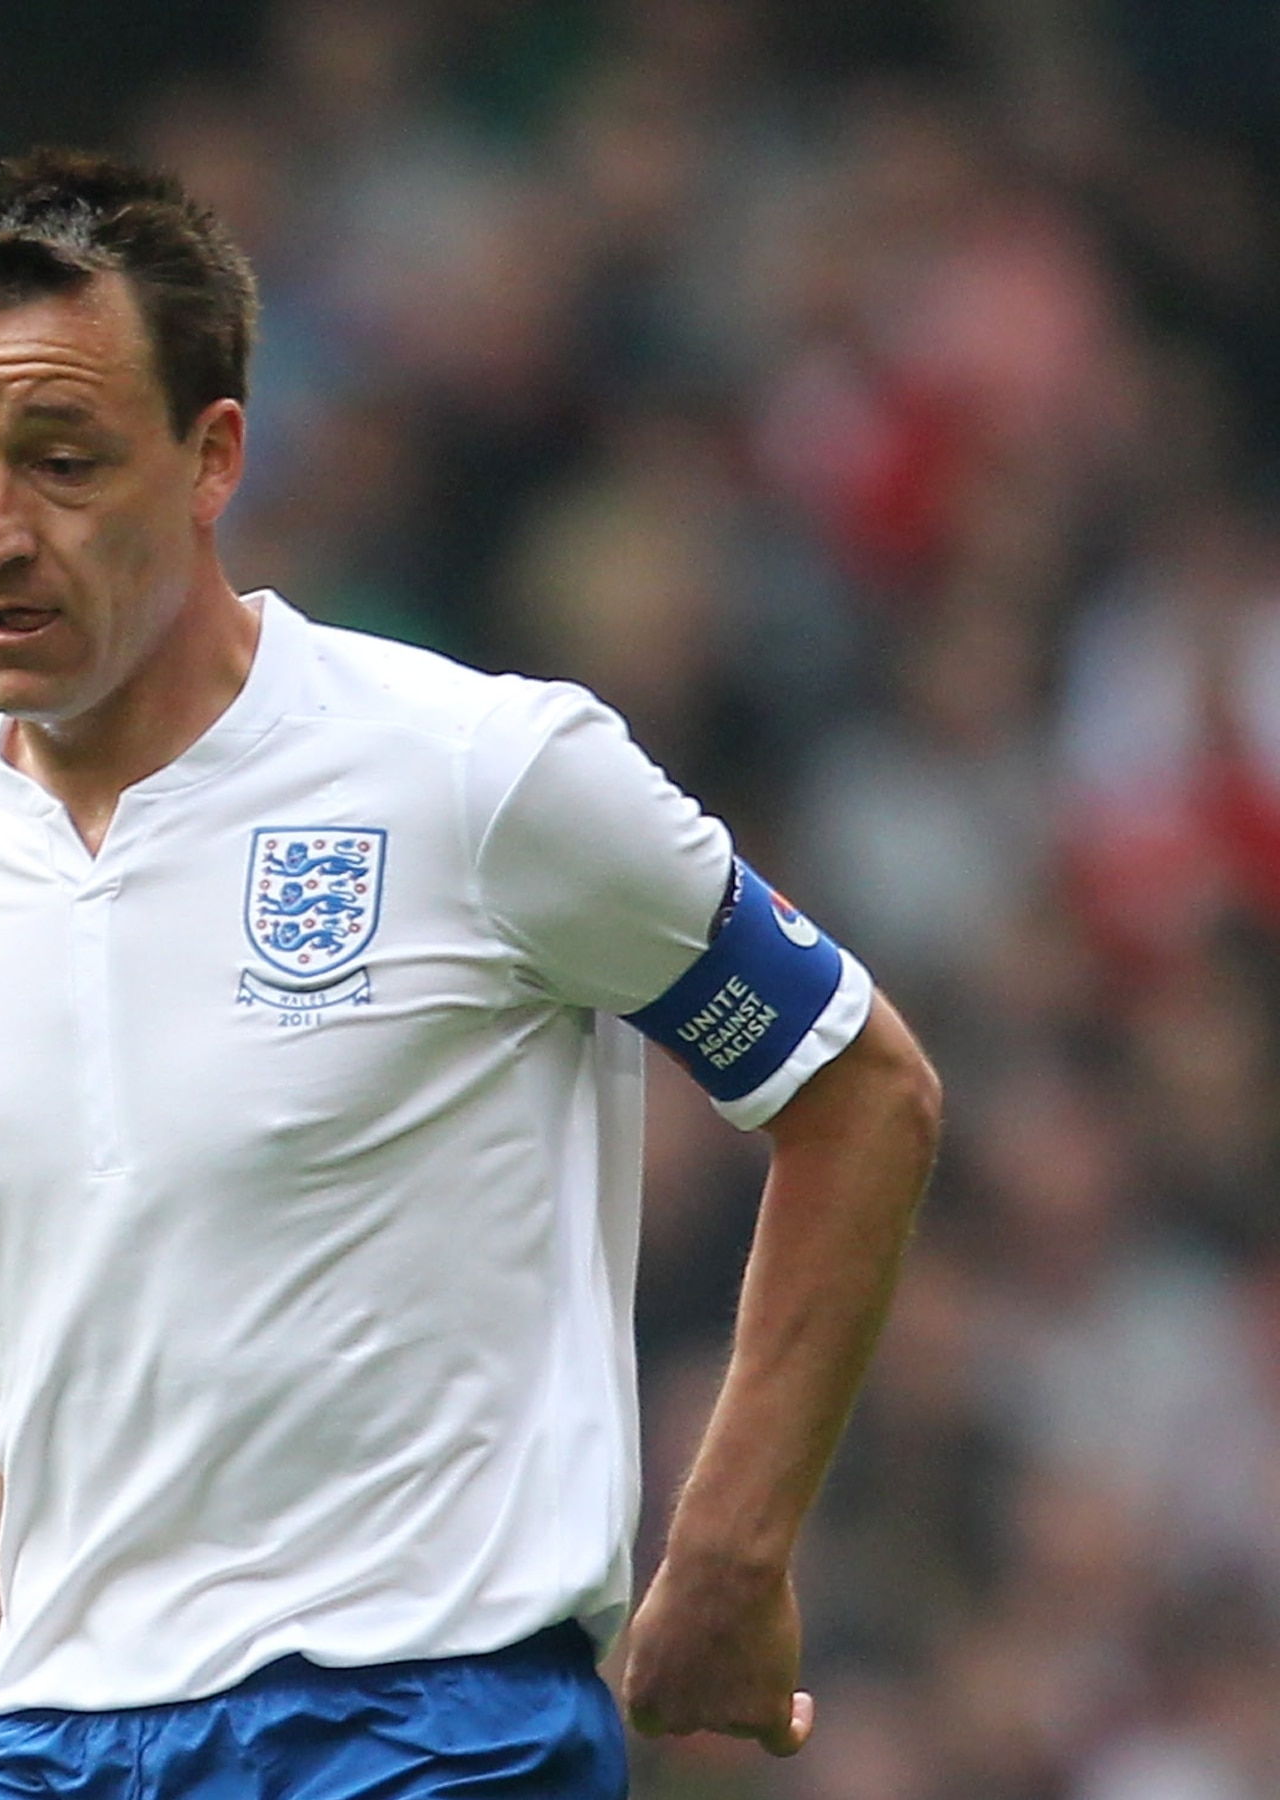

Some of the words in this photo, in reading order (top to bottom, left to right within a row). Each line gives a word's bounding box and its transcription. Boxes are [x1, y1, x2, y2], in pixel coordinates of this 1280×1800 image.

[277, 1012, 322, 1027] 2011
[677, 975, 748, 1042] UNITE
[698, 992, 762, 1056] AGAINST
[710, 1005, 779, 1070] RACISM
